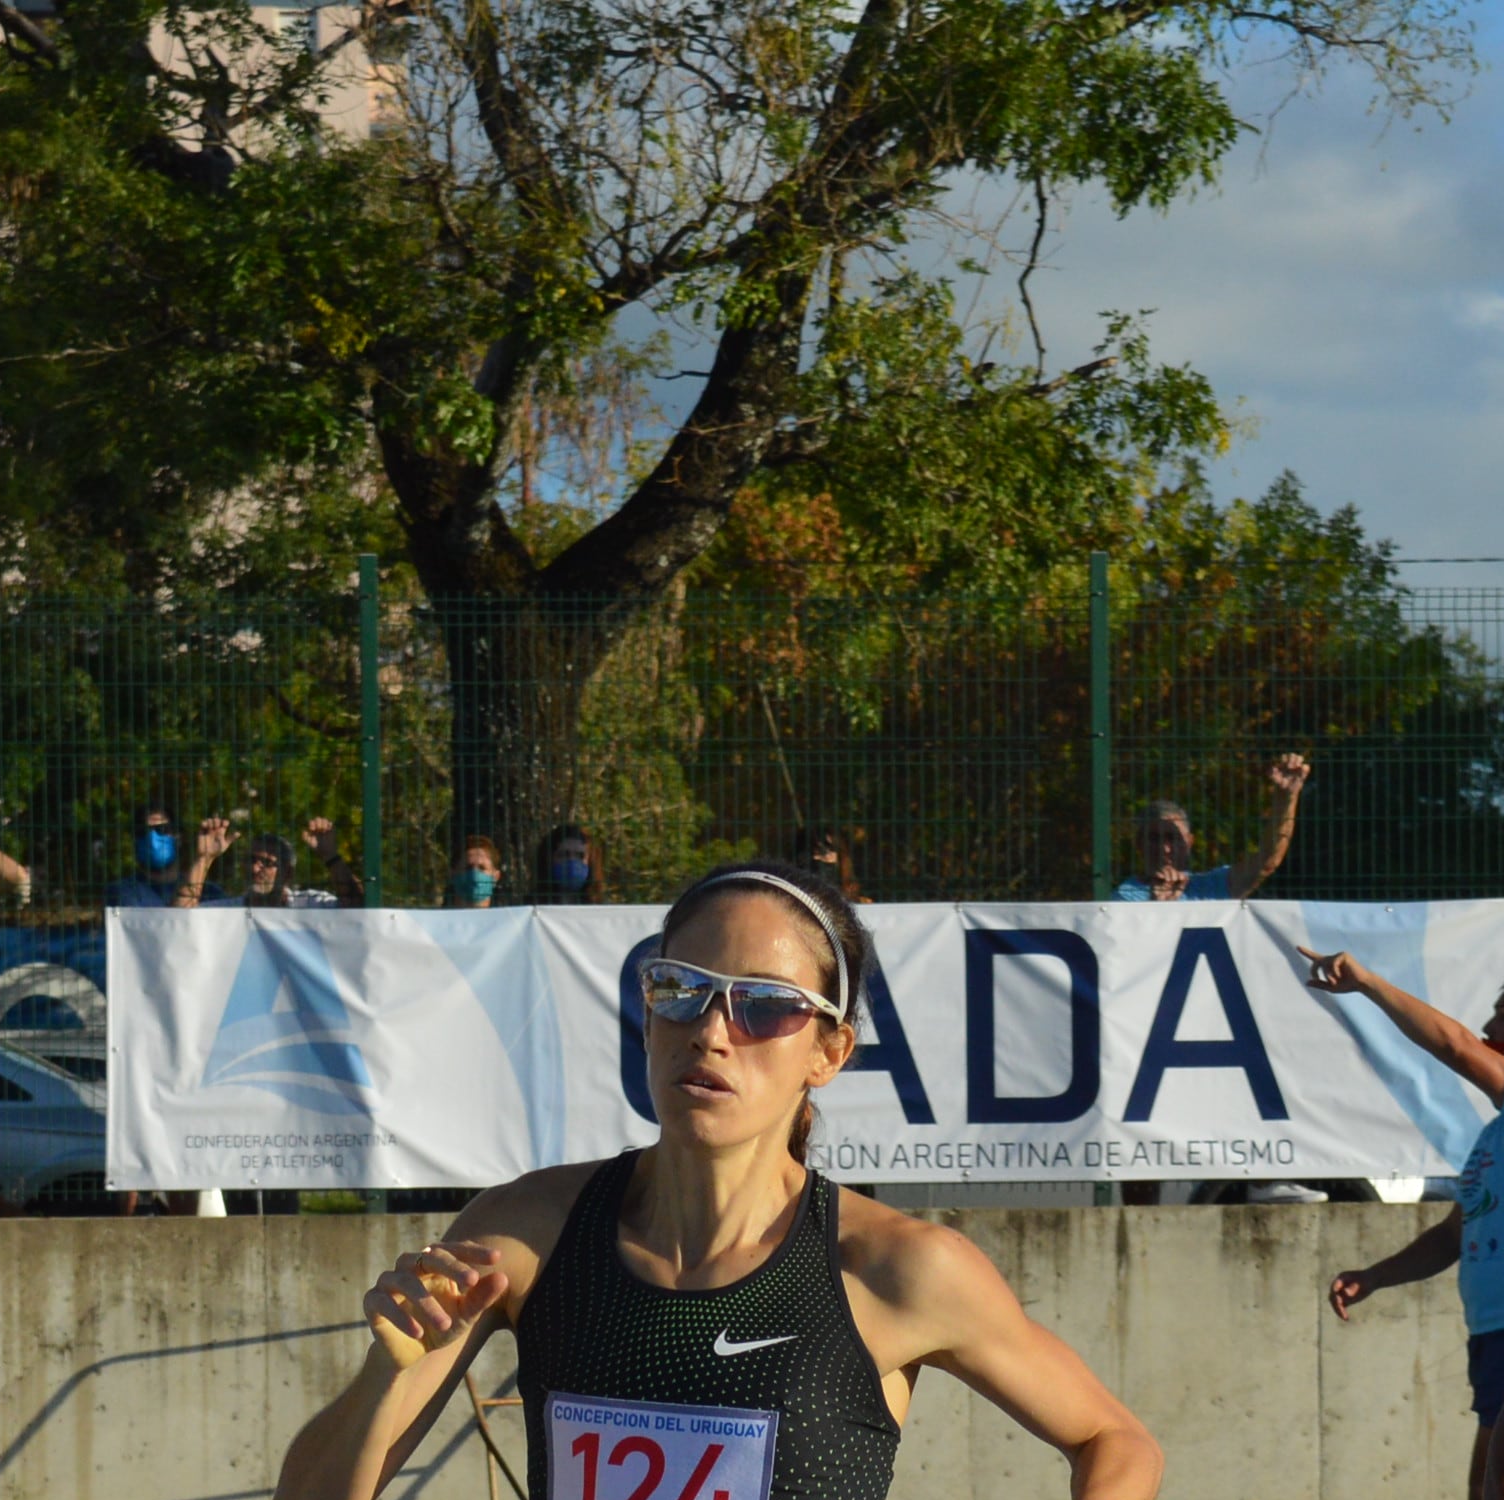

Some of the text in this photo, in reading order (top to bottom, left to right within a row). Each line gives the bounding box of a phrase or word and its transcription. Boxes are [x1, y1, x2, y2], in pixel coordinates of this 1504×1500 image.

[184, 1132, 396, 1149] CONFEDERACIÓN ARGENTINA
[240, 1153, 344, 1169] DE ATLETISMO
[889, 1142, 1073, 1169] ARGENTINA
[1083, 1141, 1122, 1168] DE
[1130, 1138, 1295, 1167] ATLETISMO
[554, 1405, 766, 1439] CONCEPCION DEL URUGUAY
